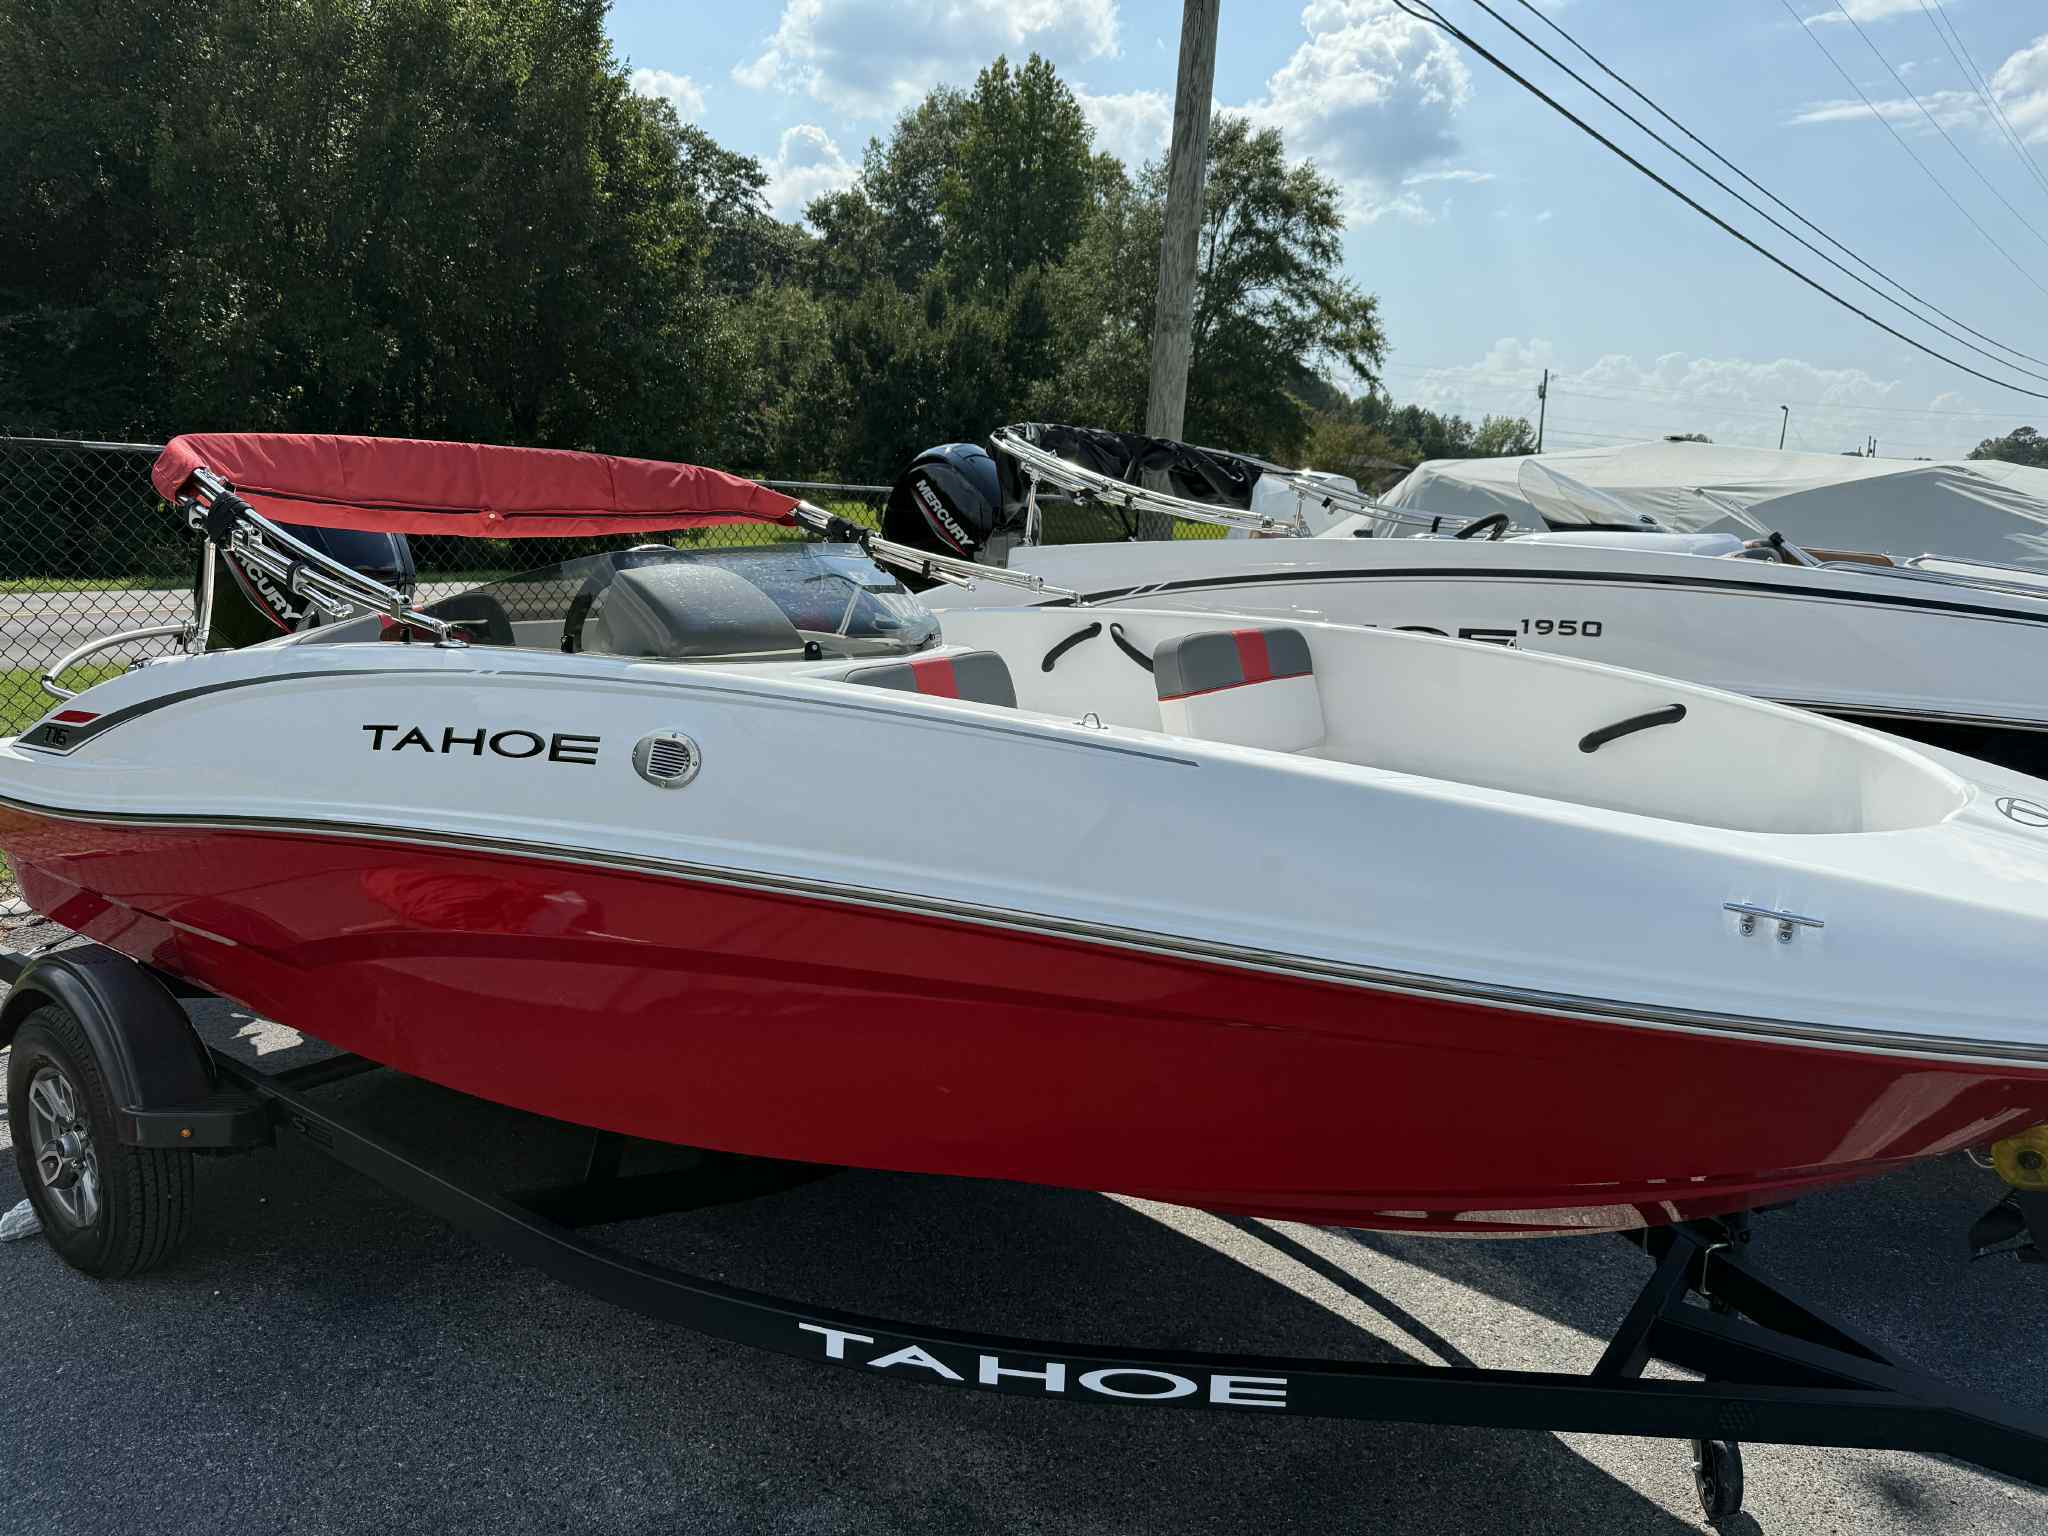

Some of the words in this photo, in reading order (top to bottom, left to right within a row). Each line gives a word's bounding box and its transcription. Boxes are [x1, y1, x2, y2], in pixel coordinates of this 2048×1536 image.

[916, 479, 974, 547] MERCURY
[234, 552, 303, 620] CURY
[1521, 618, 1603, 637] 1950
[362, 725, 600, 765] TAHOE
[799, 1322, 1288, 1407] TAHOE
